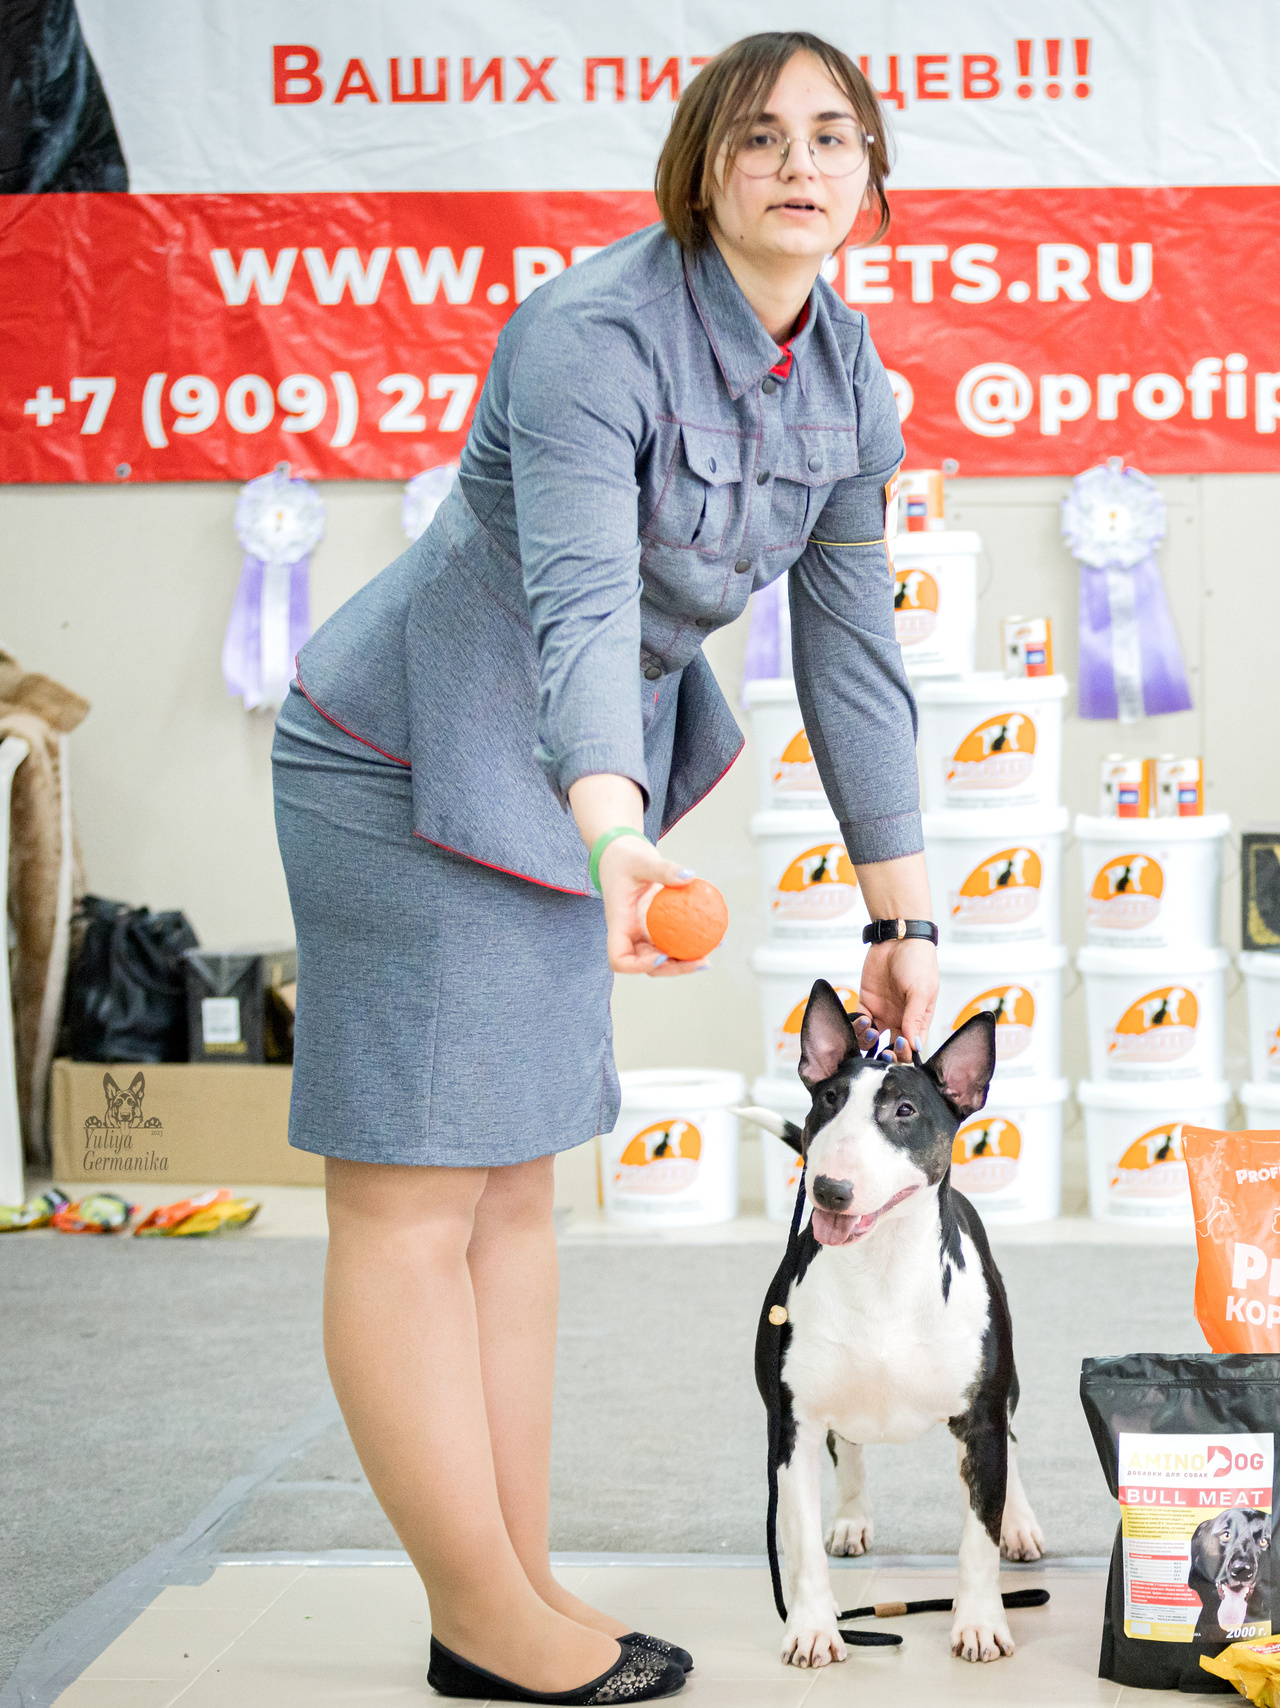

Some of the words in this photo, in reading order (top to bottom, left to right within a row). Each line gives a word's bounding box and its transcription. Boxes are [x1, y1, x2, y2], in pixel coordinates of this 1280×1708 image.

[584, 38, 1094, 109] ПИЦЕВ!!!
[24, 376, 117, 436] +7
[141, 371, 360, 448] (909)
[376, 373, 480, 434] 27
[1127, 1489, 1186, 1505] BULL
[1199, 1491, 1264, 1506] MEAT
[1226, 1626, 1256, 1639] 2000
[1258, 1626, 1267, 1636] г.
